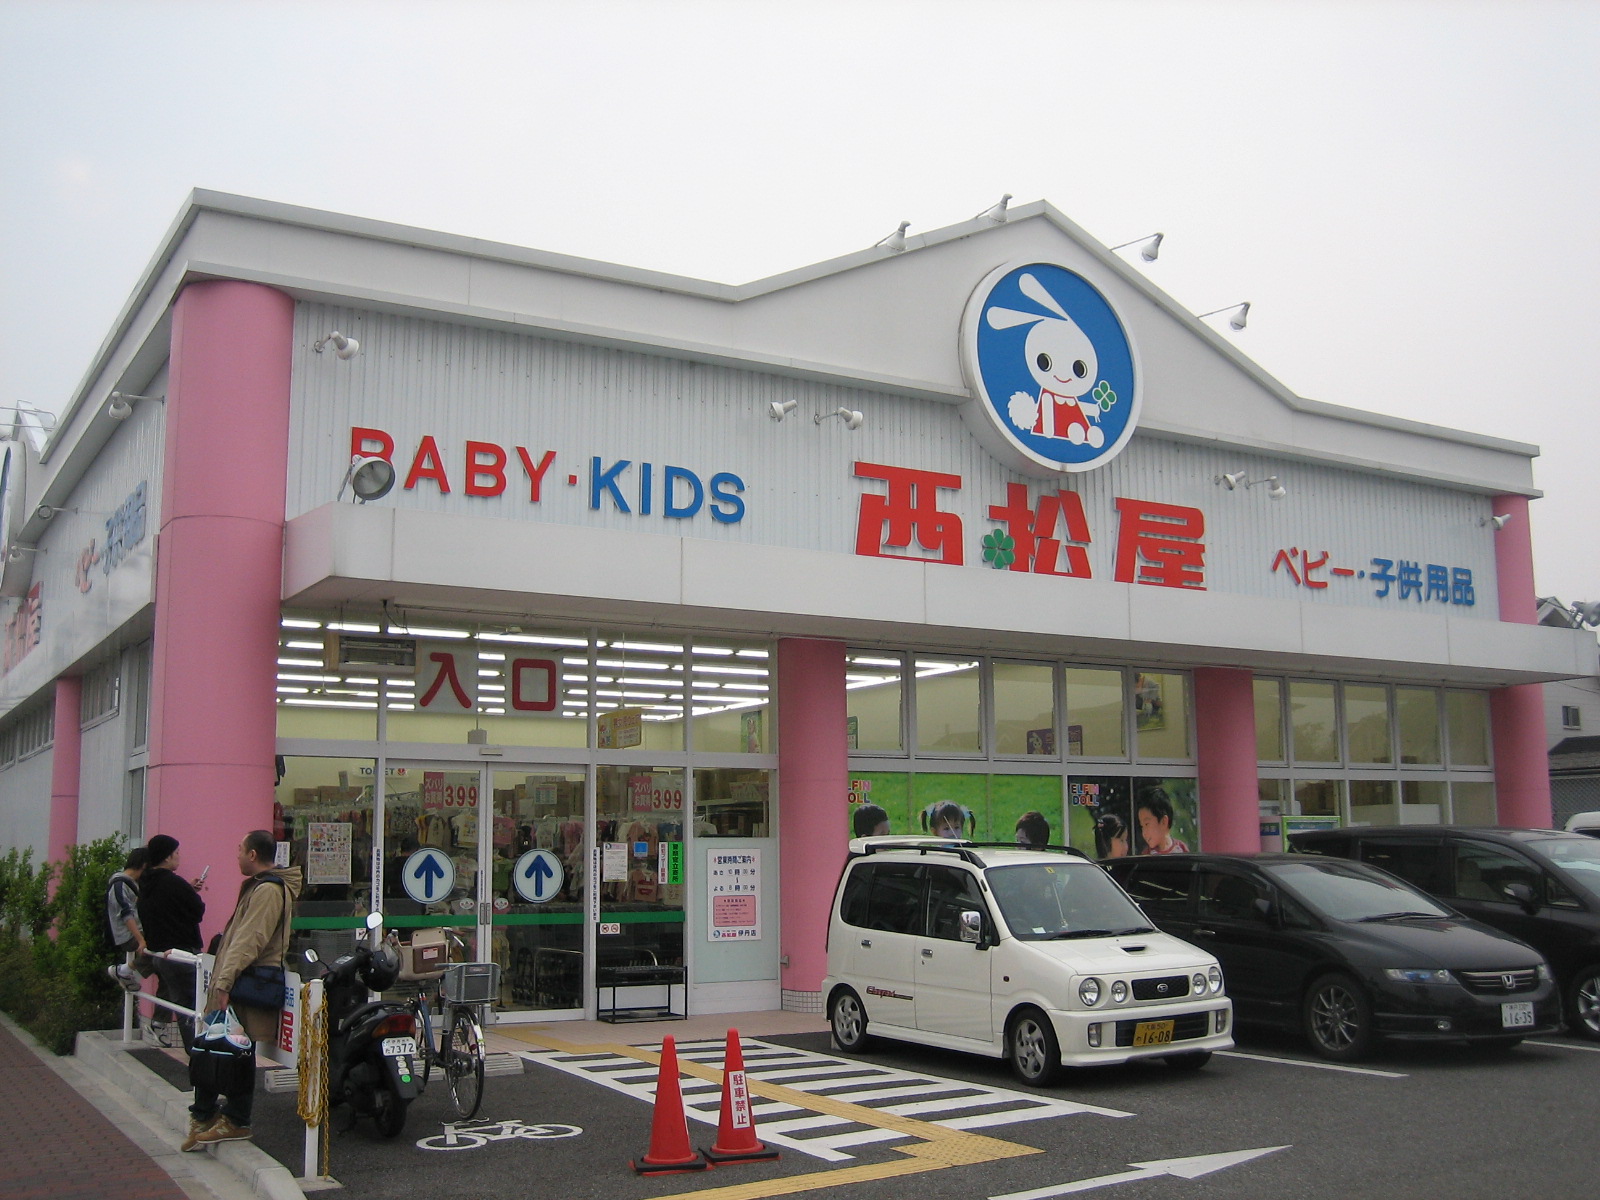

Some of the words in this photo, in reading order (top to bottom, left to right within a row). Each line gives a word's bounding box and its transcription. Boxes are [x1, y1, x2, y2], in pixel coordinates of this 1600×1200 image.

[853, 461, 1208, 591] 西松屋
[419, 652, 557, 711] 入口
[445, 785, 478, 807] 399
[1071, 784, 1099, 794] ELFIN
[653, 789, 682, 809] 399
[1073, 795, 1099, 806] DOLL
[1510, 1011, 1533, 1025] 16-35
[1142, 1030, 1171, 1044] 16-08
[390, 1042, 415, 1054] 7372
[733, 1074, 747, 1125] 駐車禁止
